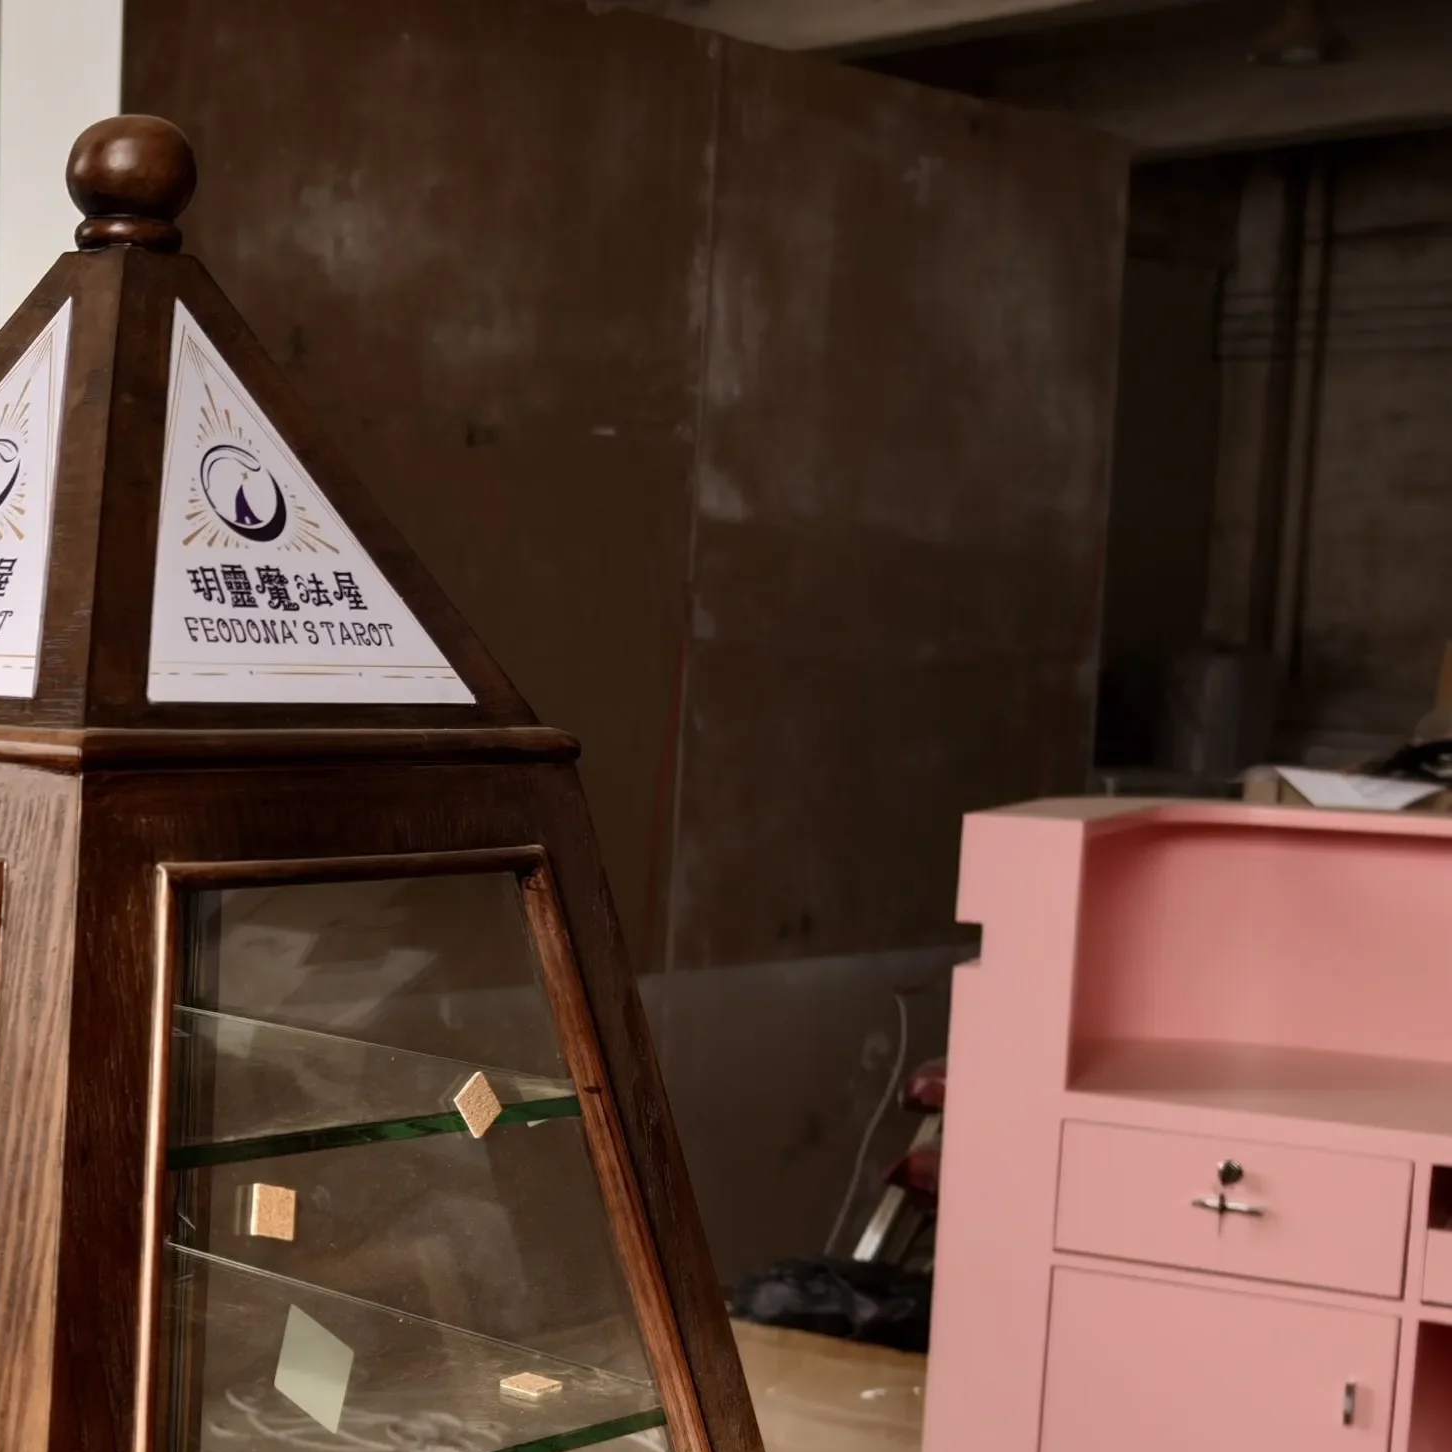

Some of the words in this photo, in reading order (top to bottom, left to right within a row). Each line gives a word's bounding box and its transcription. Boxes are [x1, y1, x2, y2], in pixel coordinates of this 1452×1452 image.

[186, 563, 368, 612] 玥靈魔法屋
[184, 616, 319, 645] FEODONA'S
[319, 621, 395, 647] TAROT
